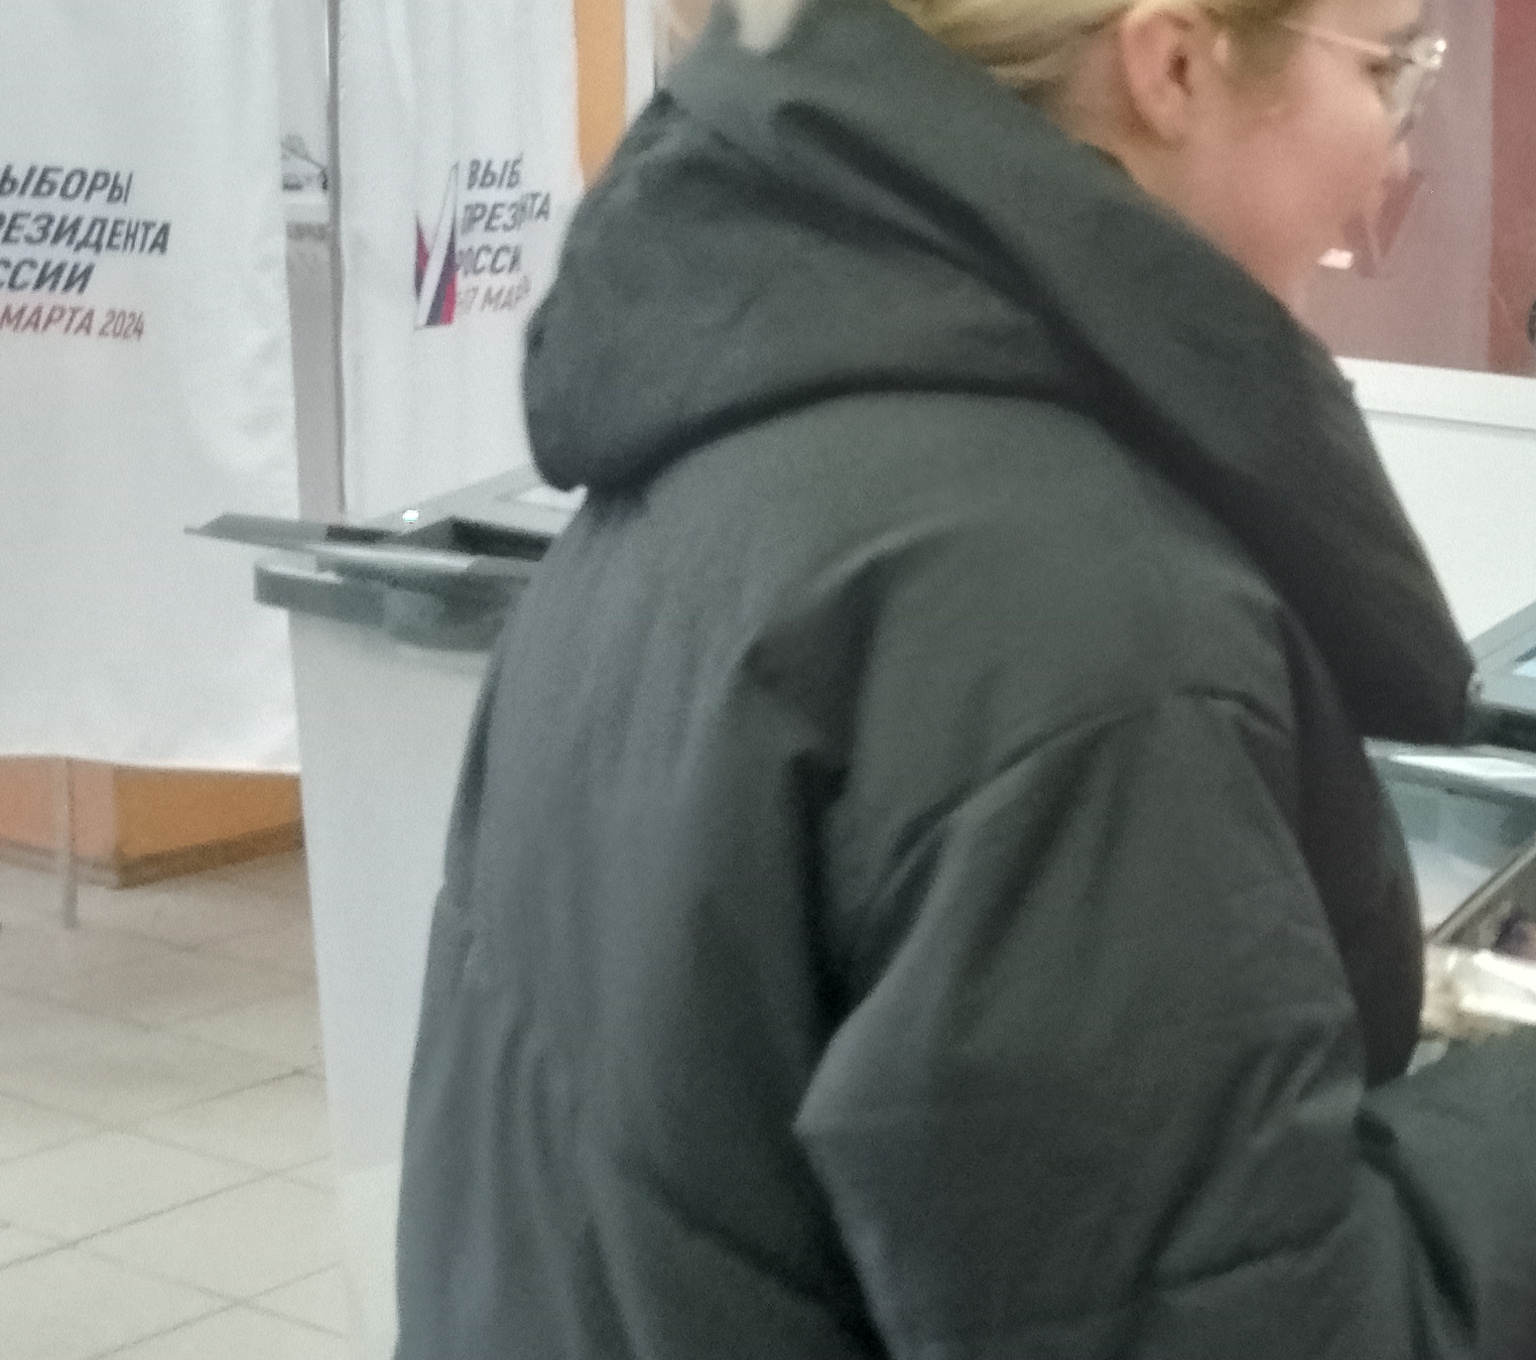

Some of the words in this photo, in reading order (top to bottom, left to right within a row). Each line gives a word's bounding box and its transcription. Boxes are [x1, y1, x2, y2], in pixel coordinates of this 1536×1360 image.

[0, 211, 171, 255] ЕЗИДЕНТА
[0, 304, 95, 335] МАРТА
[98, 308, 144, 341] 2024
